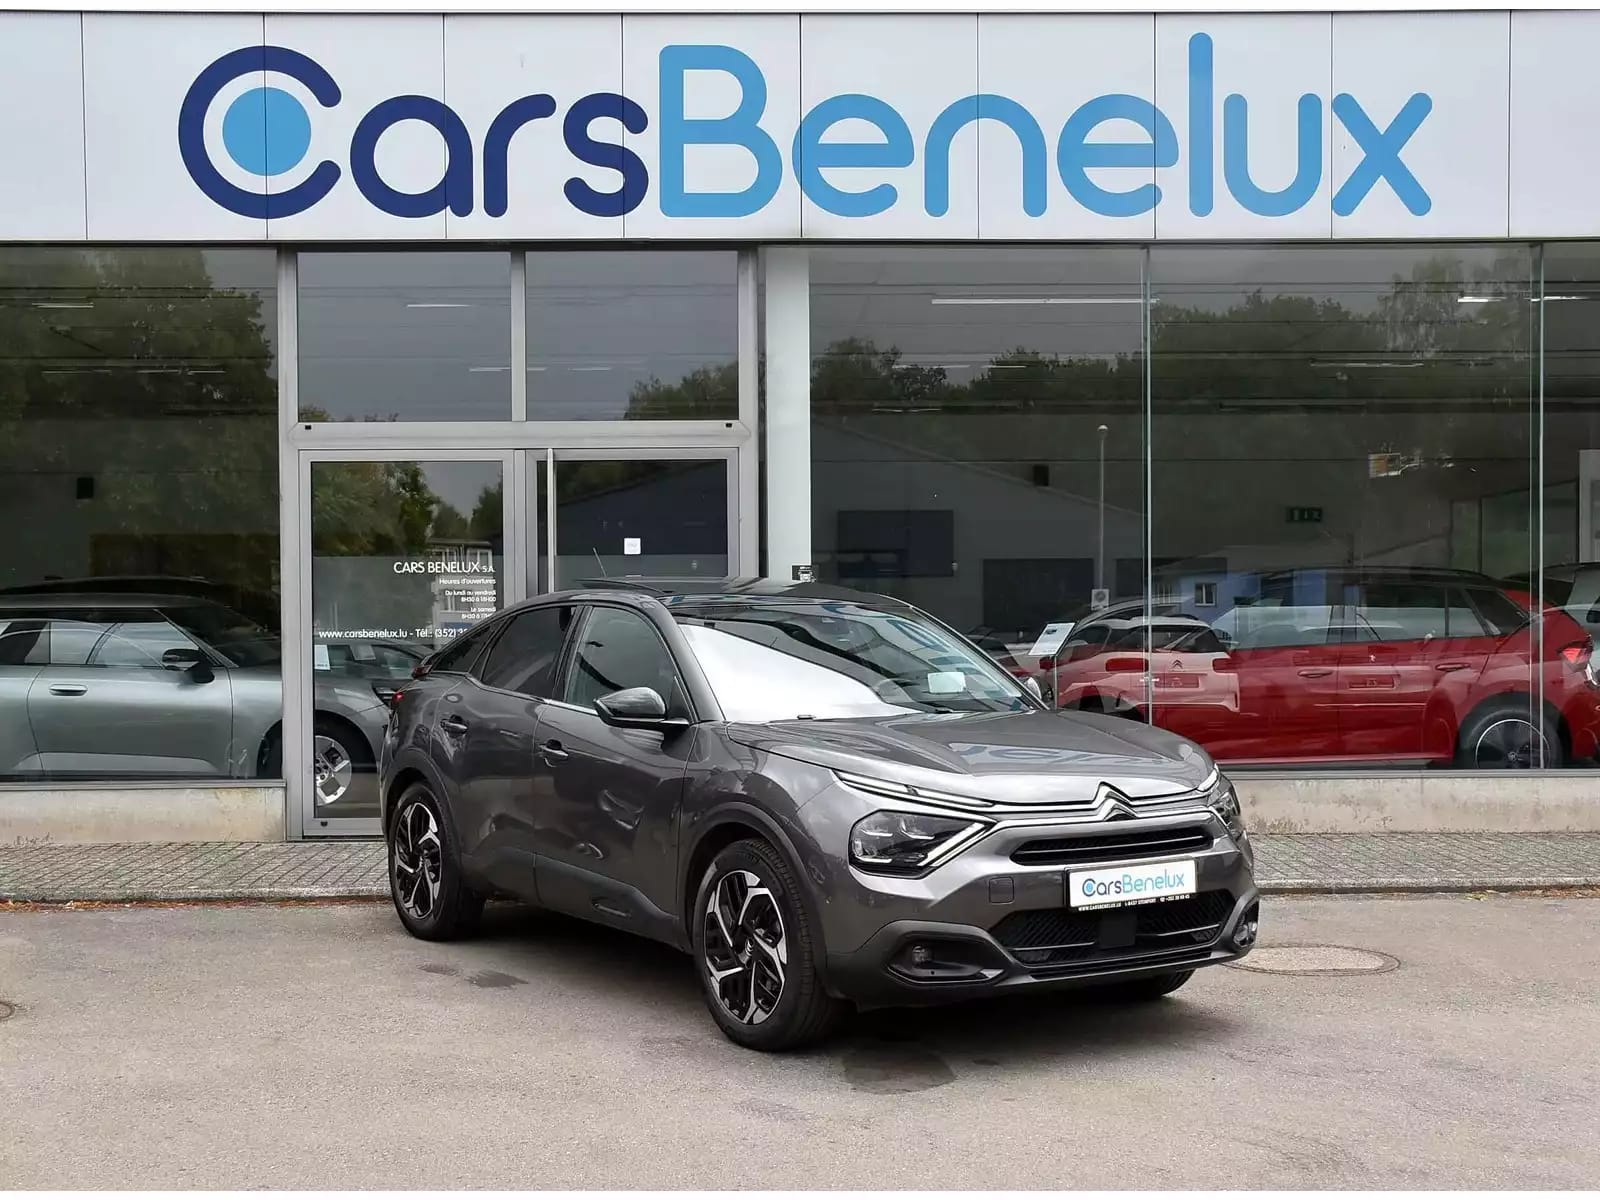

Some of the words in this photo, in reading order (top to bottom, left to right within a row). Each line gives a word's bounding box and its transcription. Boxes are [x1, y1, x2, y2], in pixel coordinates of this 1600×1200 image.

[178, 32, 1433, 219] CarsBenelux
[393, 561, 425, 574] CARS
[427, 561, 480, 574] BENELUX
[318, 628, 408, 638] www.carsbenelux.lu
[434, 628, 457, 639] (352)
[1082, 868, 1185, 897] CarsBenelux
